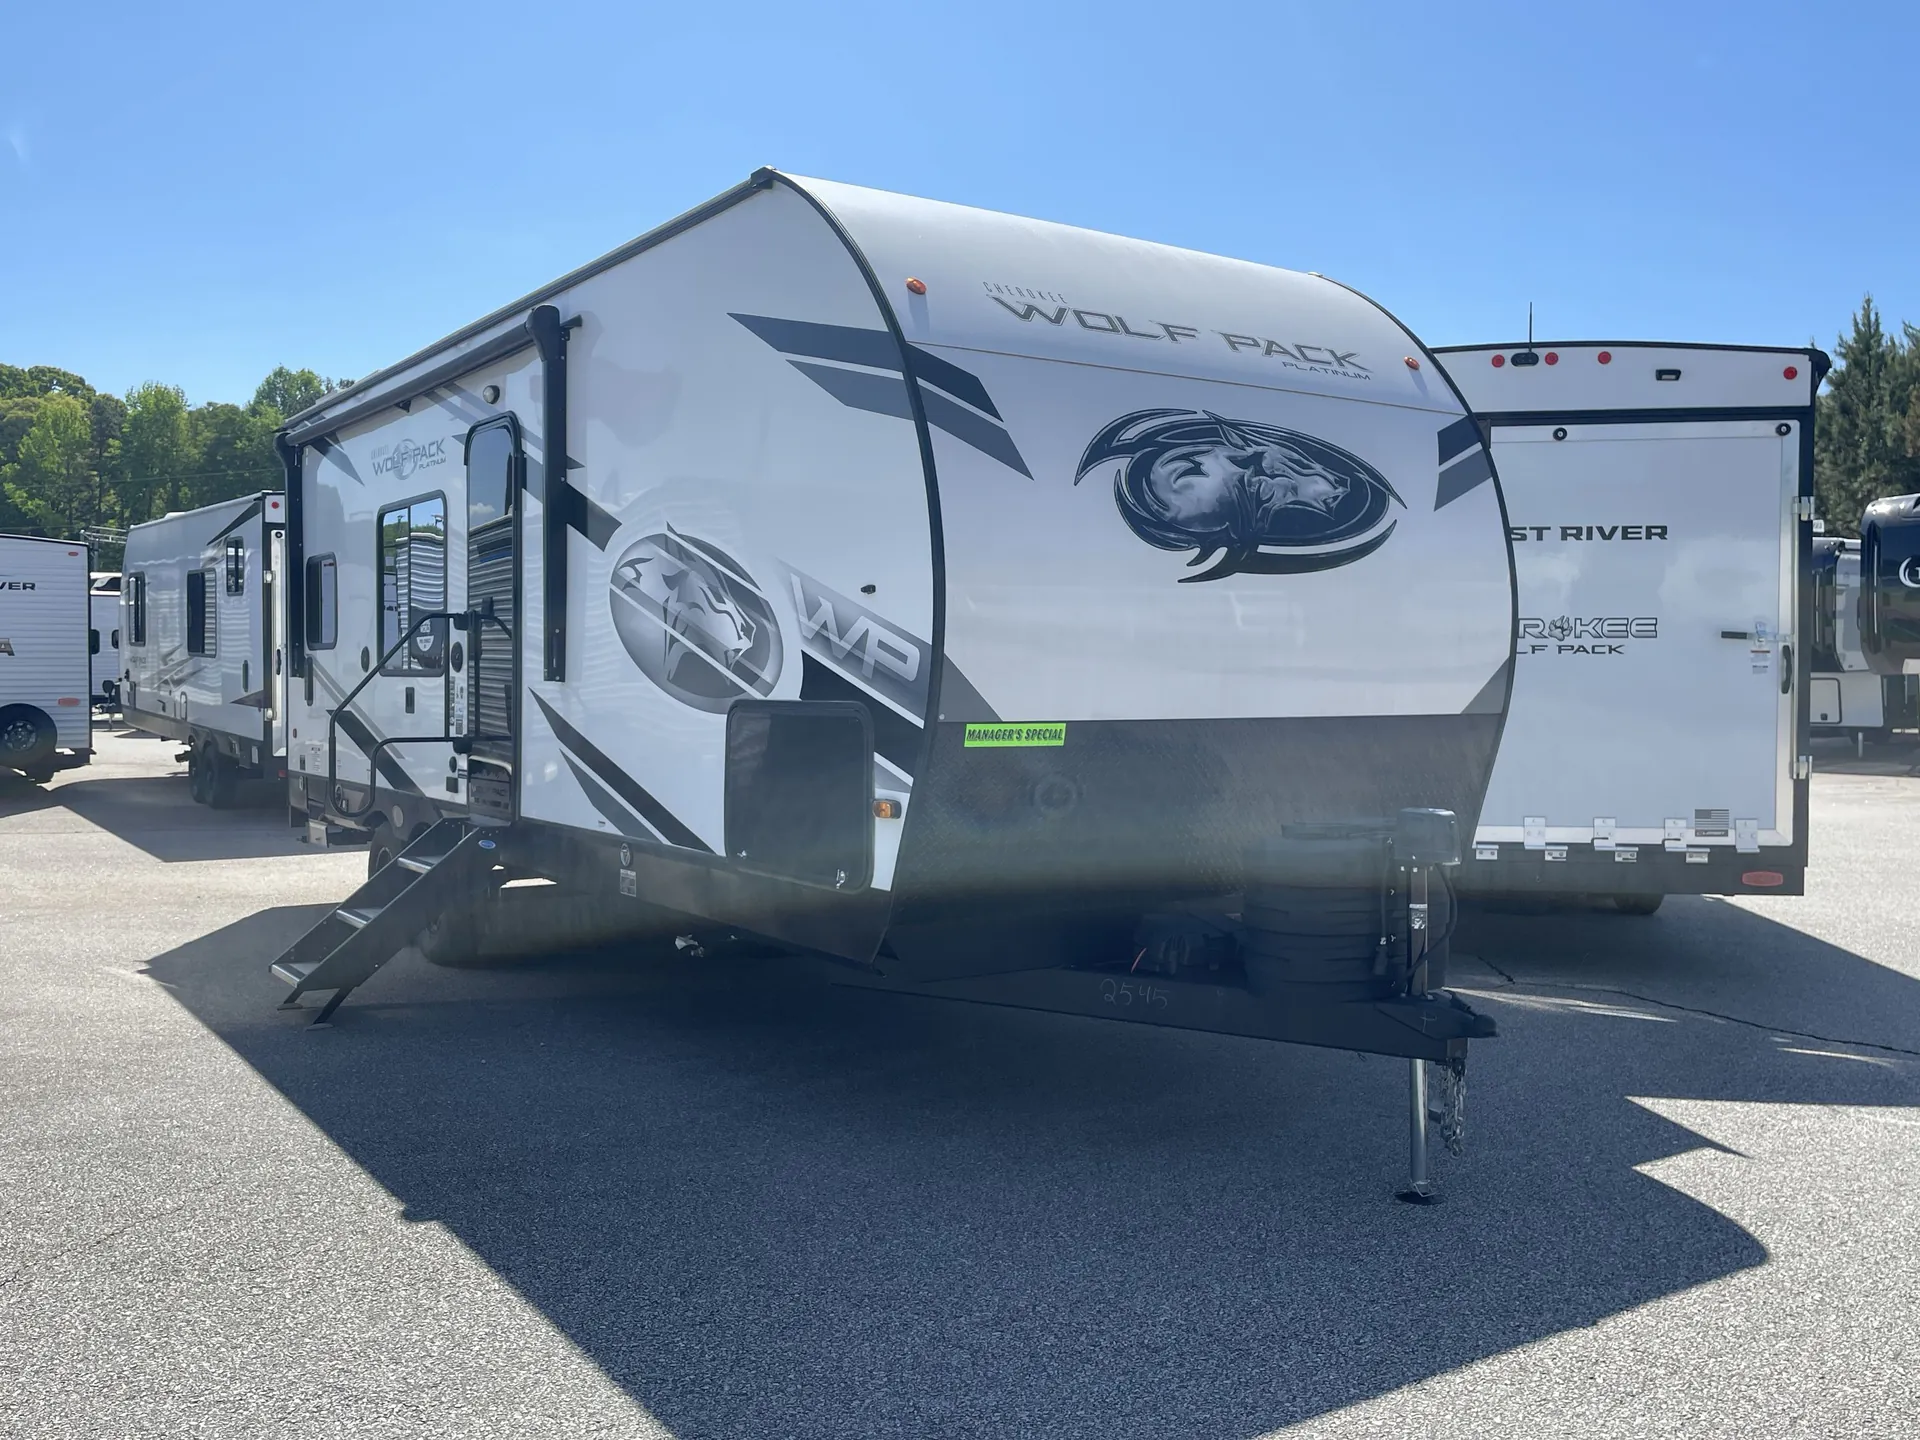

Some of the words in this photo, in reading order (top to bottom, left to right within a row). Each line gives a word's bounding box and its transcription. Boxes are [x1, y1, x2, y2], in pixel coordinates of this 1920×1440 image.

[983, 281, 1067, 303] CHEROKEE
[986, 294, 1200, 344] WOLF
[1210, 329, 1373, 373] PACK
[1282, 361, 1371, 380] PLATINUM
[412, 437, 445, 463] PACK
[1559, 525, 1668, 541] RIVER
[1556, 644, 1625, 655] PACK
[966, 728, 1023, 741] MANAGER'S
[1024, 727, 1064, 741] SPECIAL
[1100, 978, 1171, 1010] 2545
